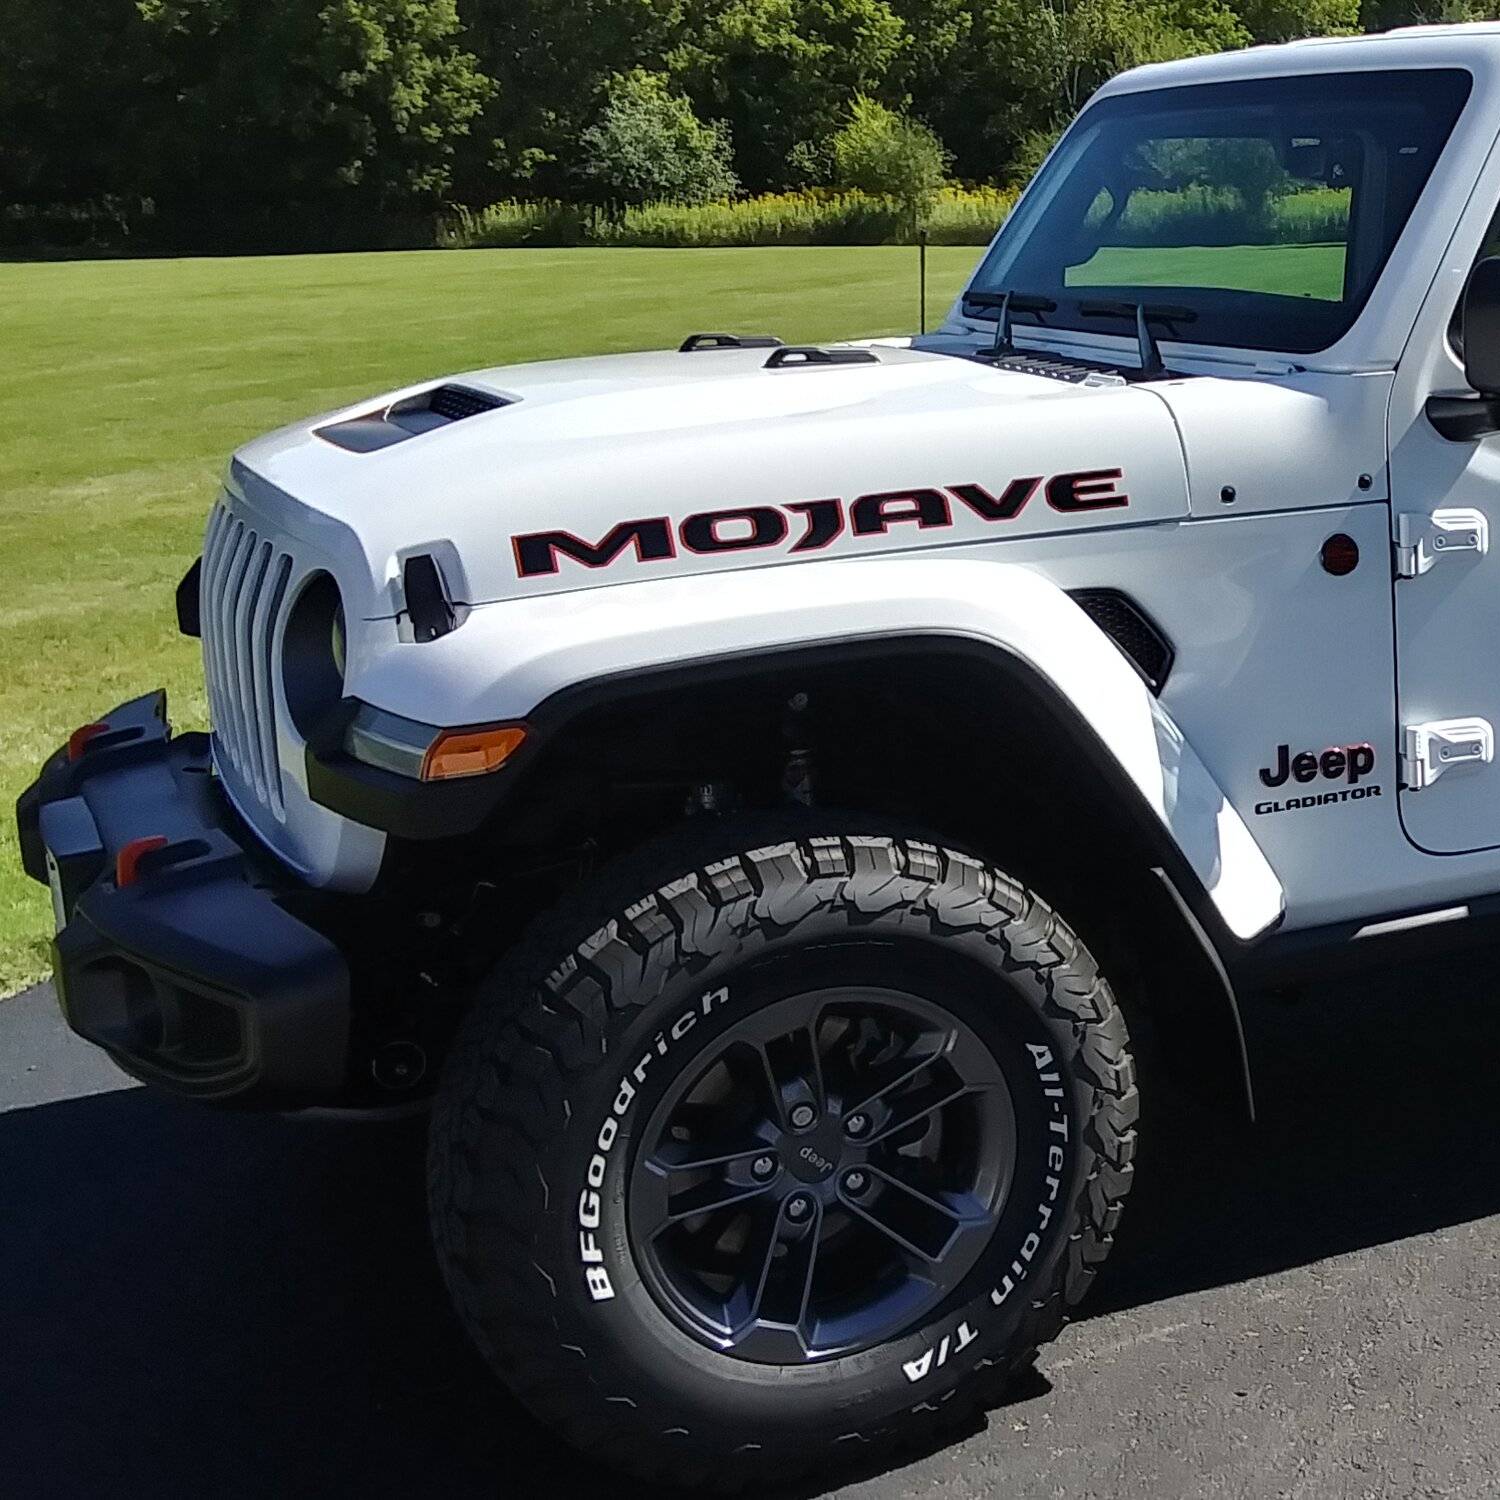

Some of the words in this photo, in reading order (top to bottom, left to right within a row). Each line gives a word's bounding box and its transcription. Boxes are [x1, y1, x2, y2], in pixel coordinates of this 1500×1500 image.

[511, 467, 1129, 578] MOJAVE
[1259, 741, 1375, 788] Jeep
[1255, 785, 1382, 815] GLADIATOR
[579, 986, 730, 1301] BFGoodrich
[800, 1147, 833, 1173] Jeep
[991, 1043, 1069, 1306] All-Terrain
[903, 1321, 979, 1383] T/A
